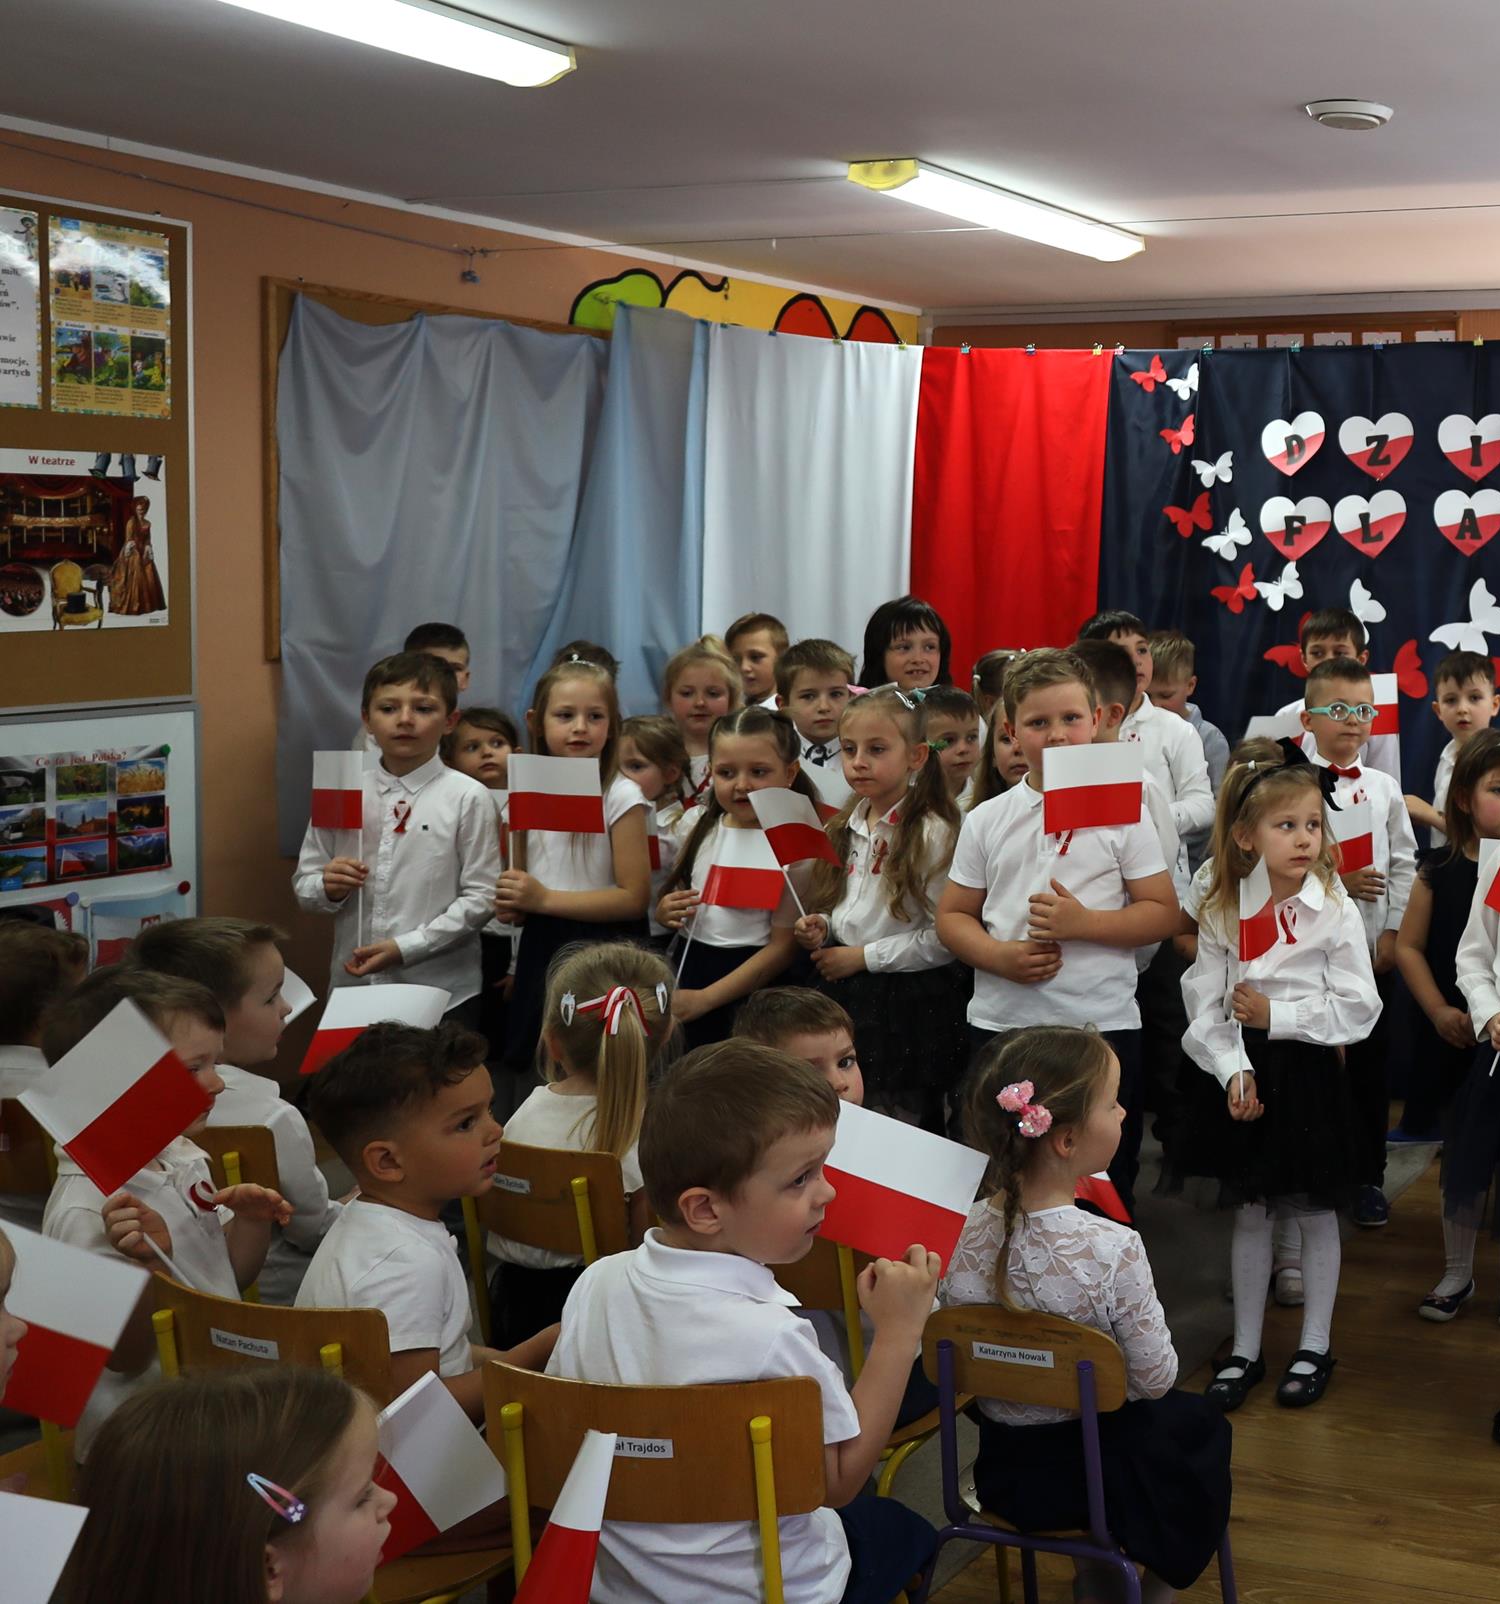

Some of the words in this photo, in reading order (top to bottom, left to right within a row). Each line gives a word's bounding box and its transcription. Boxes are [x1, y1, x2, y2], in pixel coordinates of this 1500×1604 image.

[28, 455, 39, 465] W
[41, 456, 76, 466] teatrze
[979, 1345, 1017, 1358] Katarzyna
[1018, 1351, 1047, 1362] Nowak
[627, 1442, 666, 1454] Trajdos
